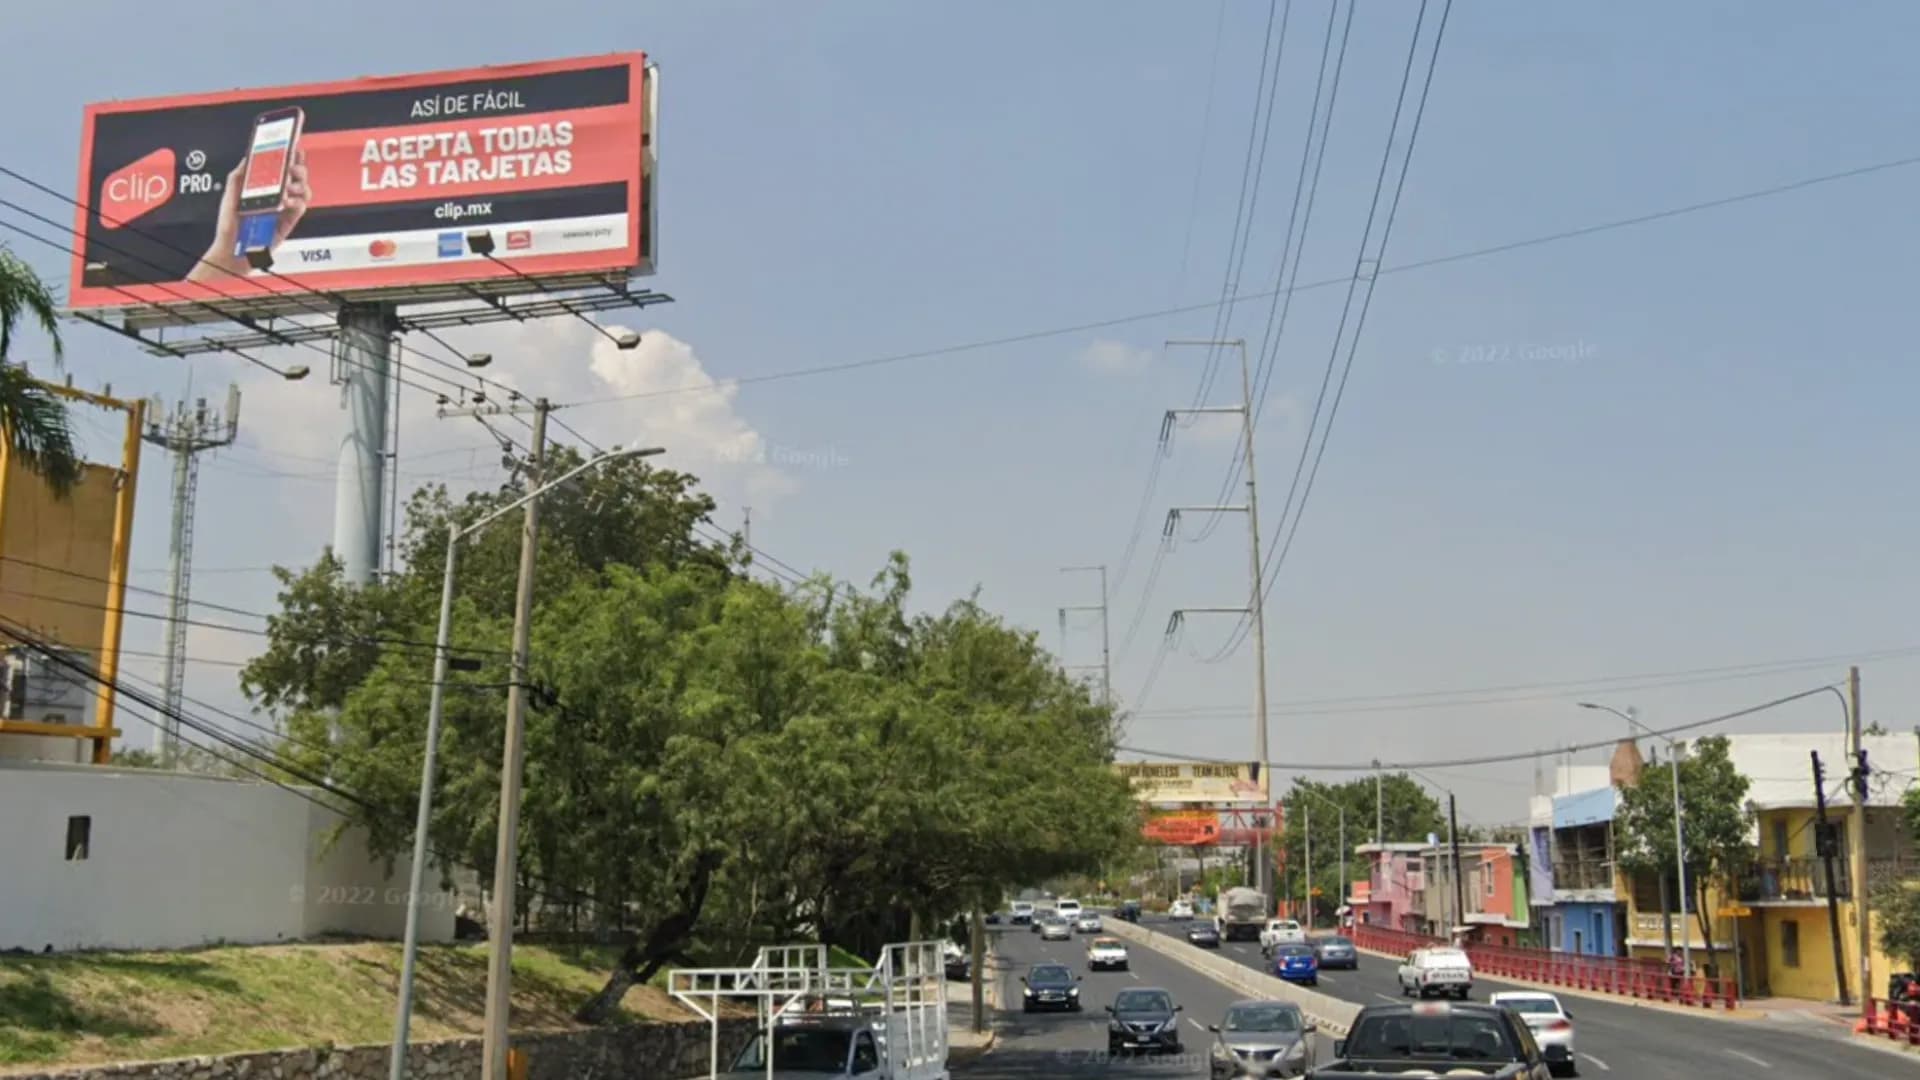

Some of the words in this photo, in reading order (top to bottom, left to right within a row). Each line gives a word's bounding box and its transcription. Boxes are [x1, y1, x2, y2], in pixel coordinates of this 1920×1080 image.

[411, 94, 440, 118] ASÍ
[444, 95, 468, 115] DE
[473, 89, 526, 112] FÁCIL
[361, 131, 473, 164] ACEPTA
[480, 120, 573, 153] TODAS
[361, 163, 418, 190] LAS
[424, 149, 572, 185] TARJETAS
[108, 173, 167, 203] clip
[434, 202, 492, 221] clip.mx
[300, 249, 332, 262] VISA
